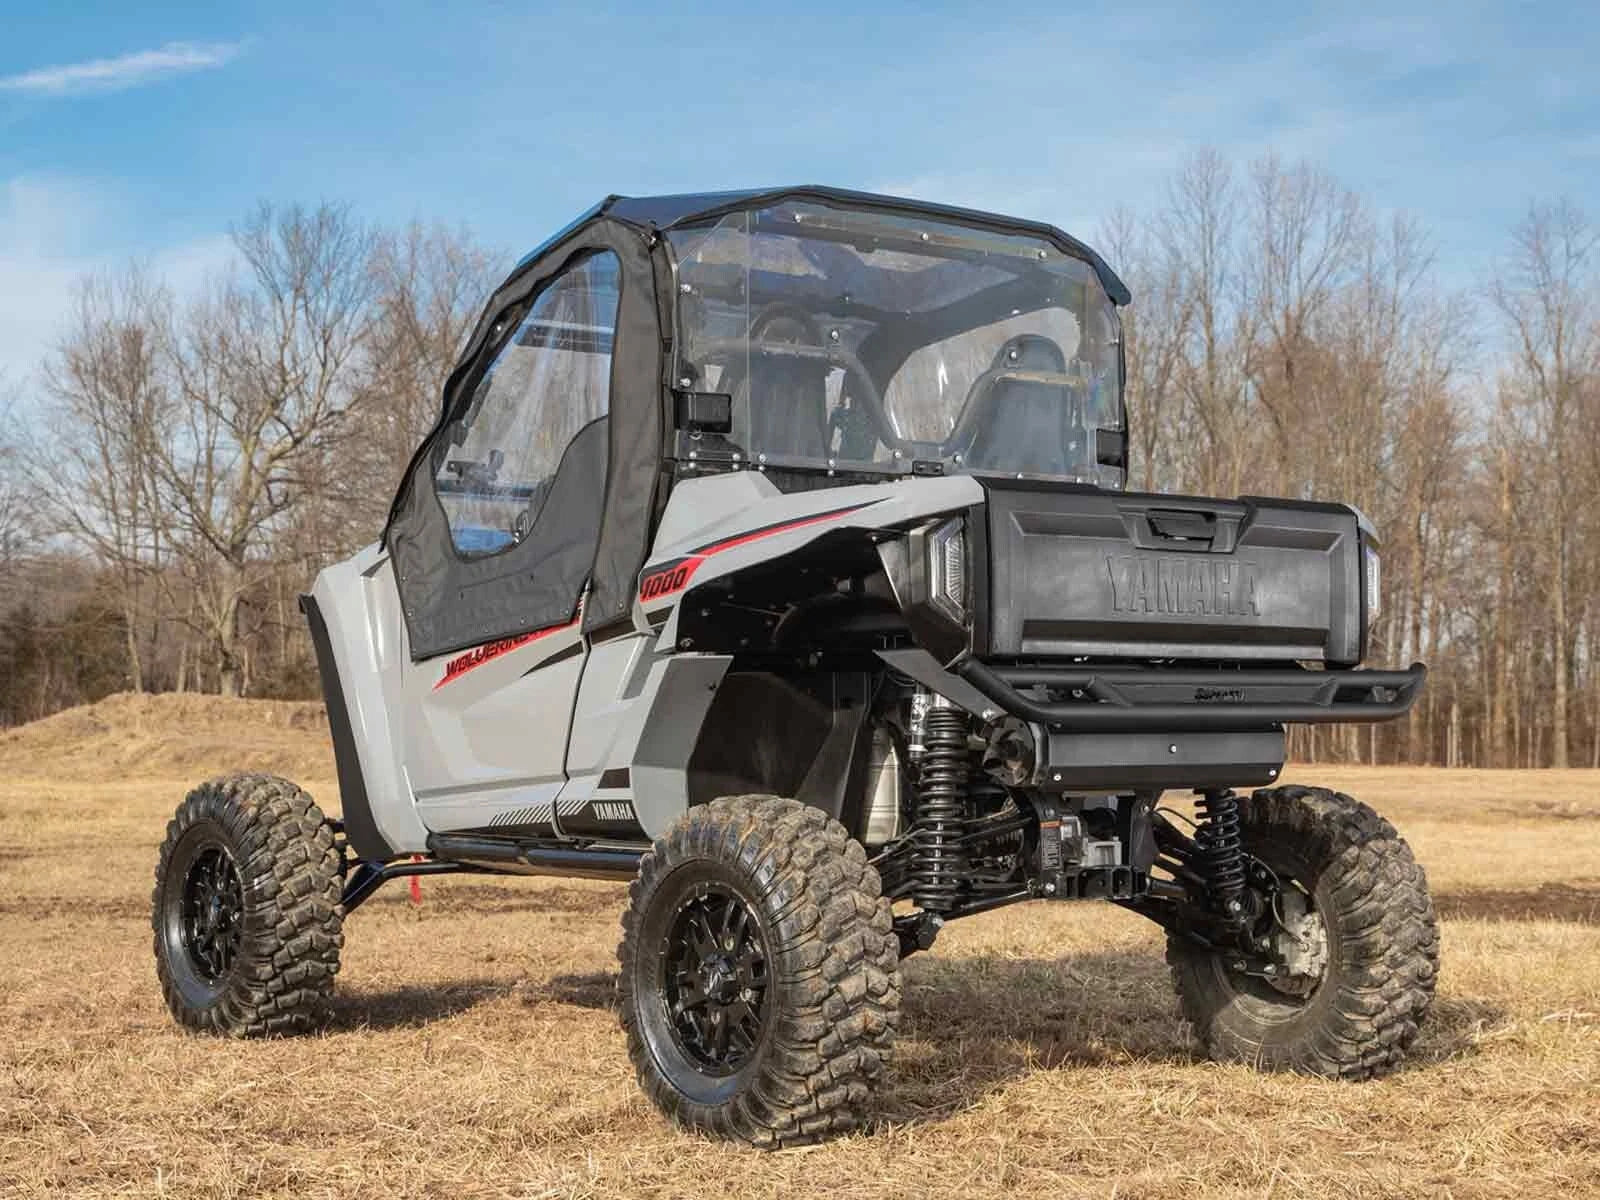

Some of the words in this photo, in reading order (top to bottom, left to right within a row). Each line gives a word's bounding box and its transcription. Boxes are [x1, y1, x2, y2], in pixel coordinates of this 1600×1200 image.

[642, 567, 688, 600] 1000
[1104, 555, 1262, 616] YAMAHA
[591, 802, 635, 820] YAMAHA
